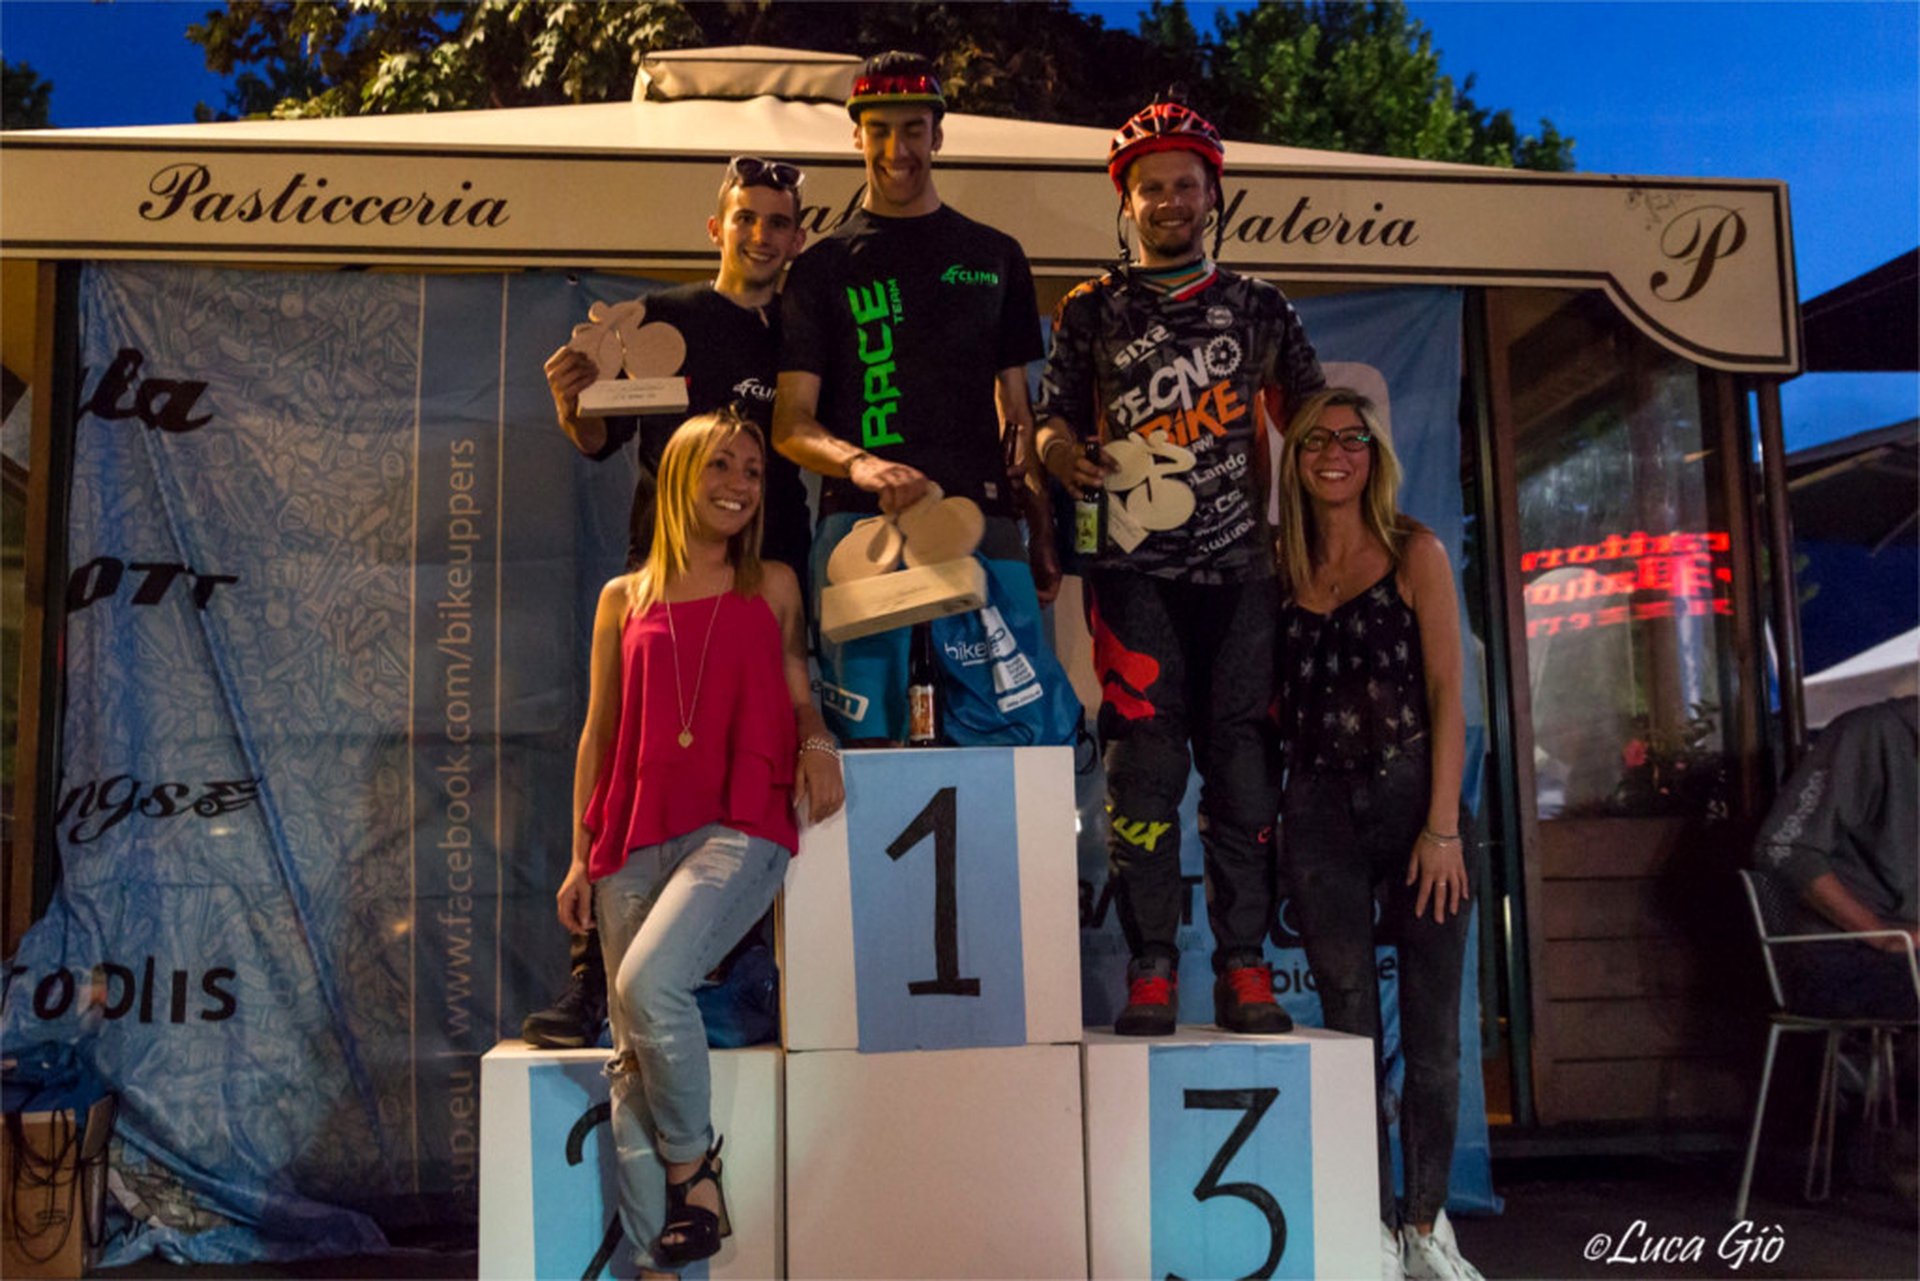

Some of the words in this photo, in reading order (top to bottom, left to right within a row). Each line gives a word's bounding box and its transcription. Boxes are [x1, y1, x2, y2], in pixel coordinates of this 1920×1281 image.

[138, 162, 510, 228] Pasticceria
[1650, 204, 1747, 303] P
[846, 280, 904, 449] RACE
[886, 786, 981, 997] 1
[1164, 1087, 1288, 1281] 3
